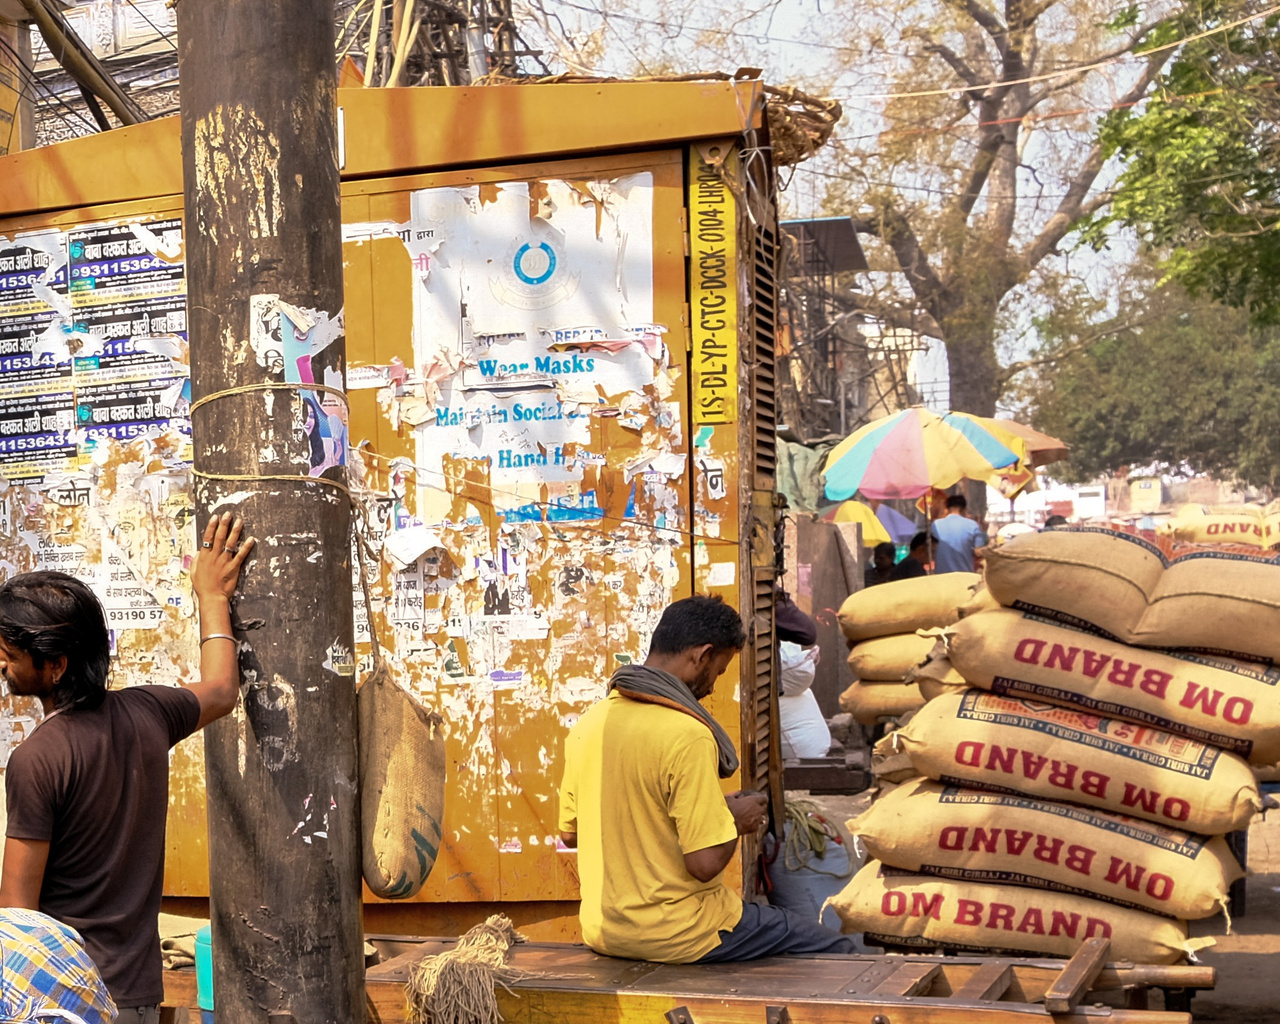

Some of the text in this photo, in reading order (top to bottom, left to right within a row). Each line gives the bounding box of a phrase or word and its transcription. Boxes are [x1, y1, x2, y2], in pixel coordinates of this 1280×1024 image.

[80, 257, 168, 277] 93115364
[534, 353, 595, 376] Masks
[109, 610, 163, 621] 93190 57
[1014, 638, 1254, 726] OM BRAND
[960, 709, 995, 722] GIRRAJ
[1019, 717, 1036, 727] JAI
[1045, 723, 1080, 740] GIRRAJ
[1081, 734, 1103, 748] SHRI
[1103, 741, 1121, 753] JAI
[1128, 747, 1166, 767] GIRRAJ
[1165, 758, 1190, 774] SHRI
[1190, 765, 1209, 777] JAI
[954, 740, 1191, 822] OM BRAND
[942, 793, 979, 804] GIRRAJ
[1091, 818, 1109, 829] JAI
[1116, 824, 1152, 842] GIRRAJ
[1153, 835, 1177, 851] SHRI
[1177, 845, 1196, 858] JAI
[938, 826, 1175, 901] OM BRAND
[881, 890, 945, 921] OM
[953, 898, 1113, 942] BRAND
